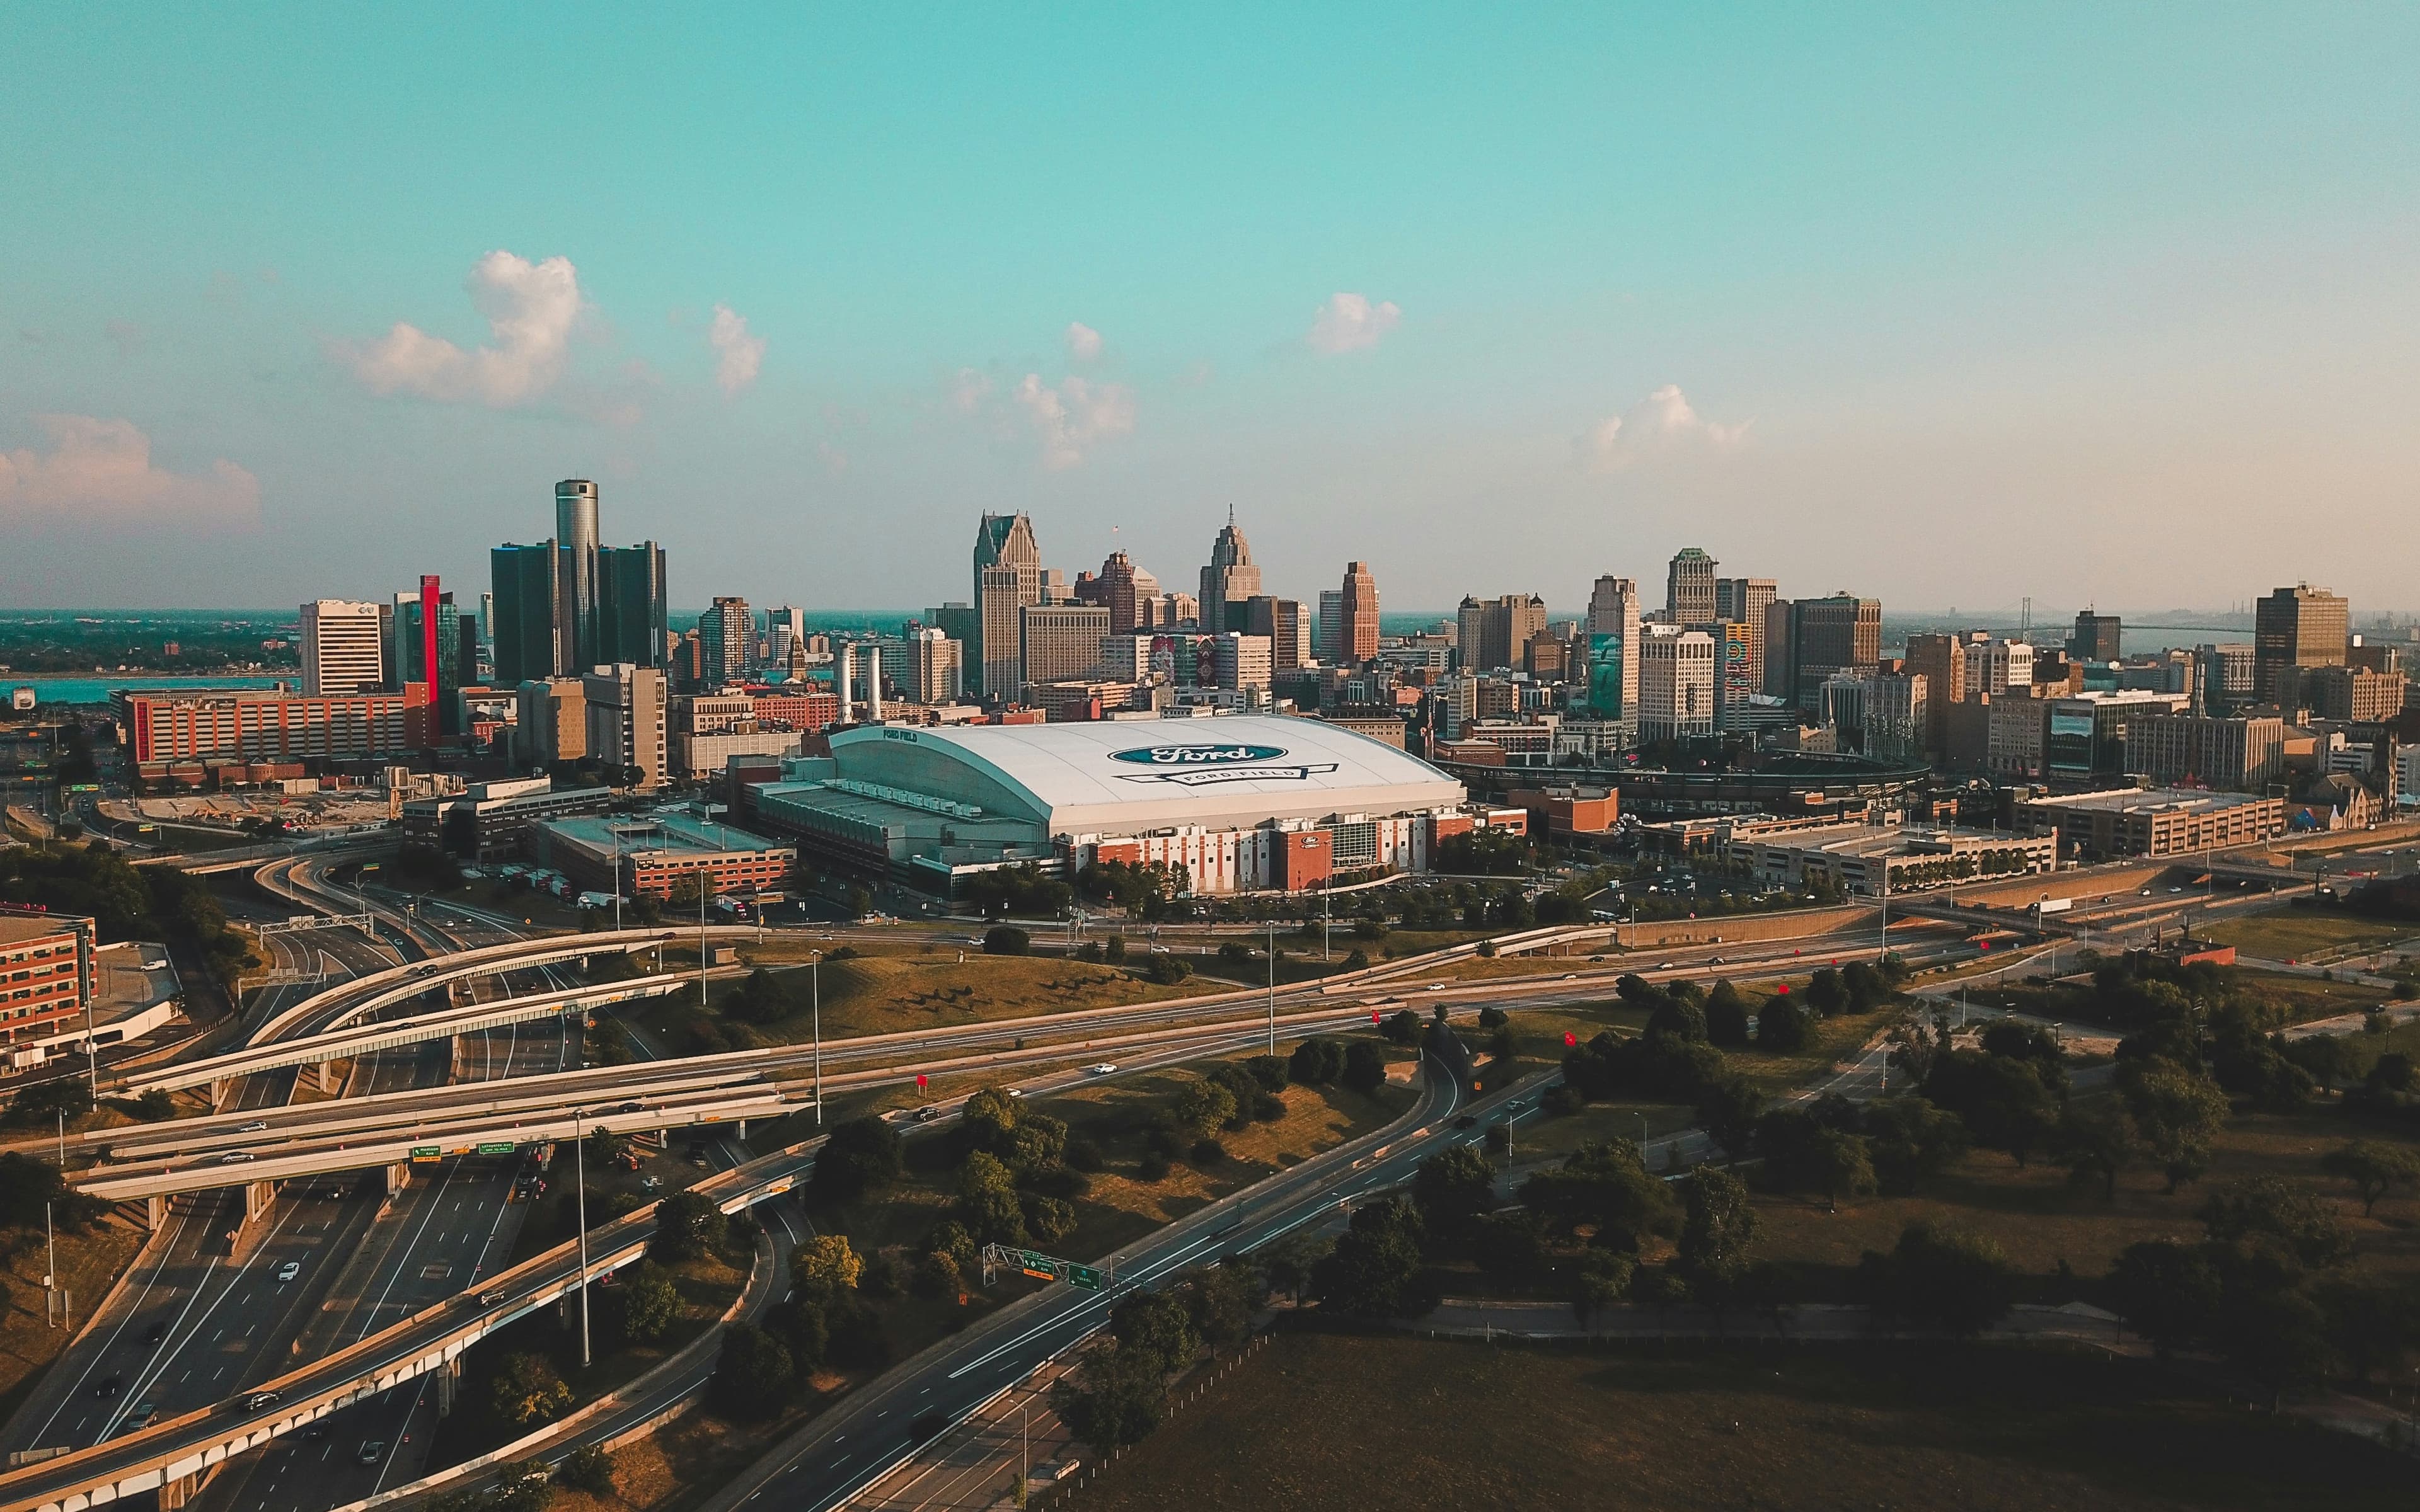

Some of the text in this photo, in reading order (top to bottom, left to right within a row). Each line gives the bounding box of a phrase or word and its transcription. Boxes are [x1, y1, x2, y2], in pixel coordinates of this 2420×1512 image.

[883, 729, 918, 743] FORD FIELD
[1150, 745, 1255, 763] Ford
[1184, 772, 1231, 781] FORD
